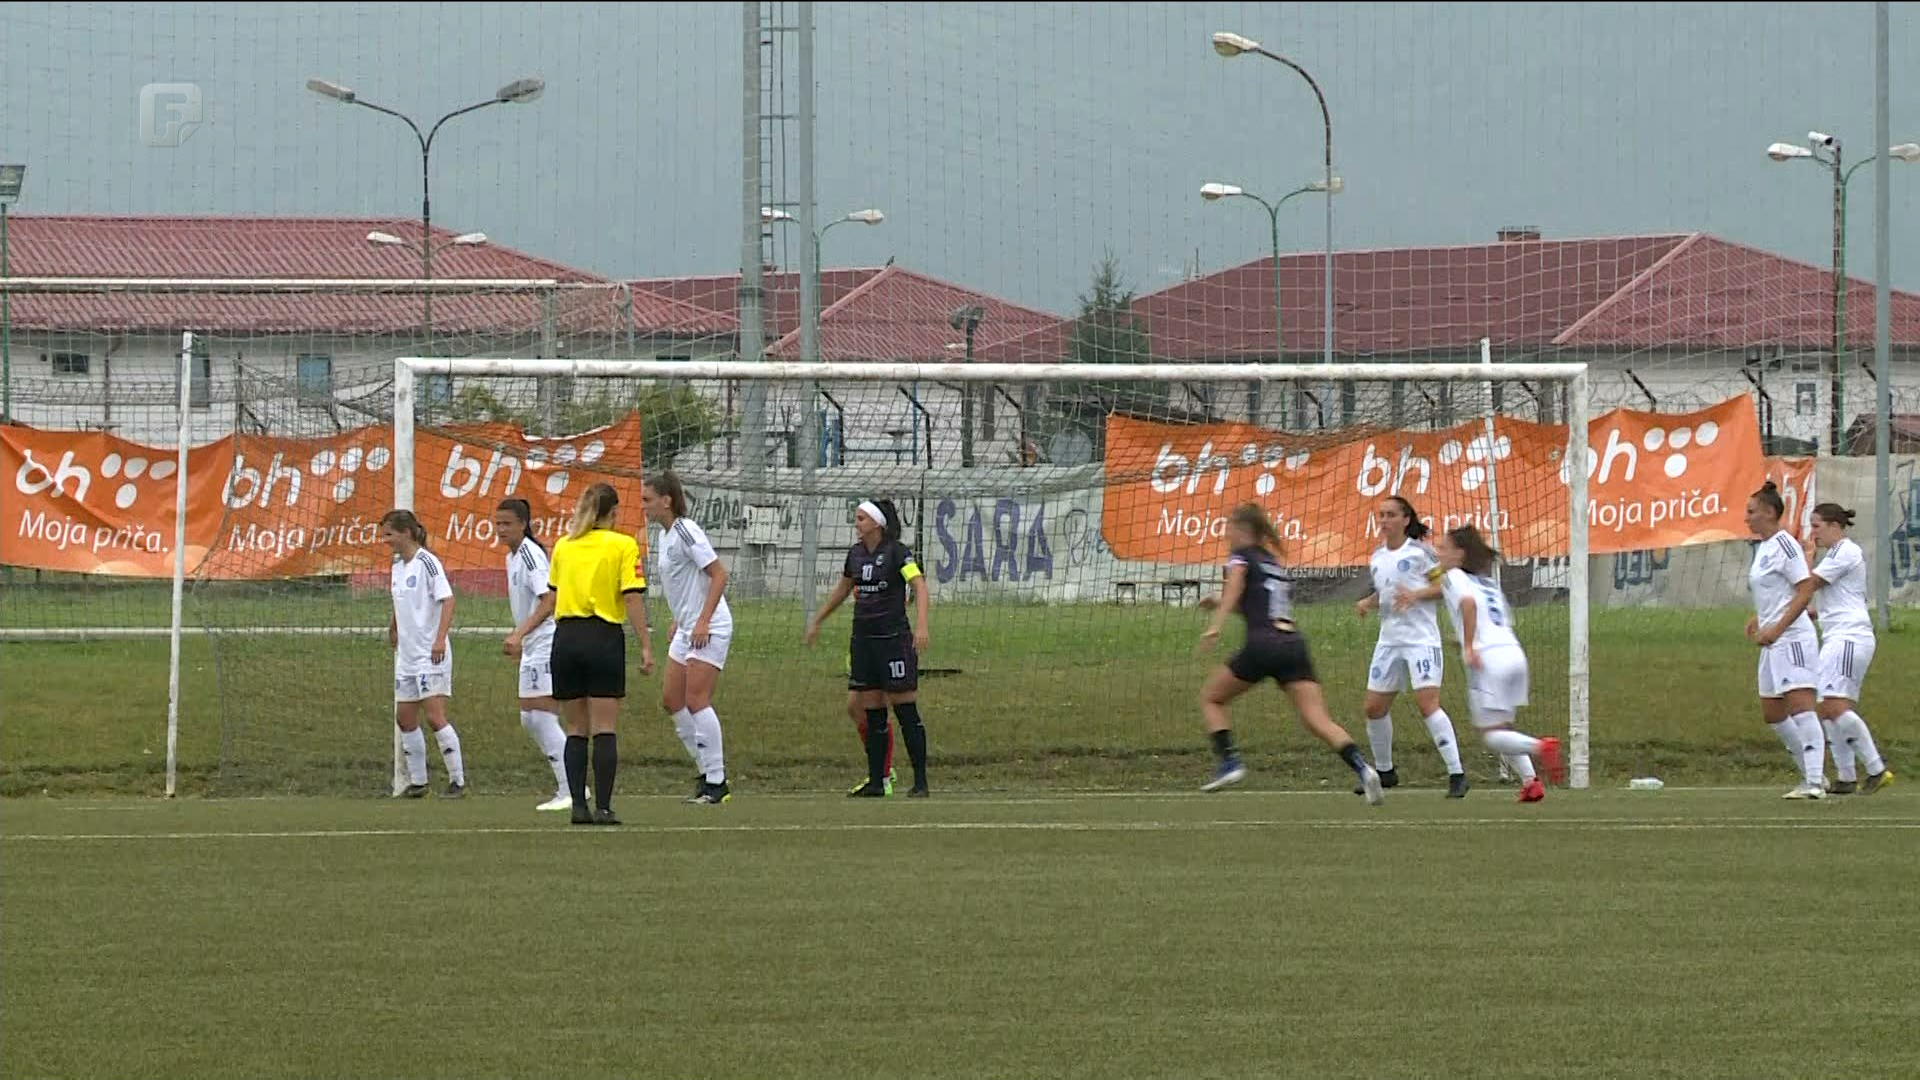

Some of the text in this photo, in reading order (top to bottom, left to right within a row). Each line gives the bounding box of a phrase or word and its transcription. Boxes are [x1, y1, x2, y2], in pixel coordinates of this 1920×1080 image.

[15, 449, 91, 503] bh
[221, 452, 301, 508] bh
[439, 444, 522, 498] bh
[1150, 441, 1231, 495] bh
[1356, 443, 1431, 496] bh
[1157, 508, 1228, 544] Moja
[1650, 489, 1728, 528] priča.
[18, 509, 169, 553] Moja priča.
[228, 522, 304, 558] Moja
[935, 498, 1054, 584] SARA
[862, 563, 874, 581] 10
[889, 660, 906, 679] 10
[1416, 659, 1431, 673] 19
